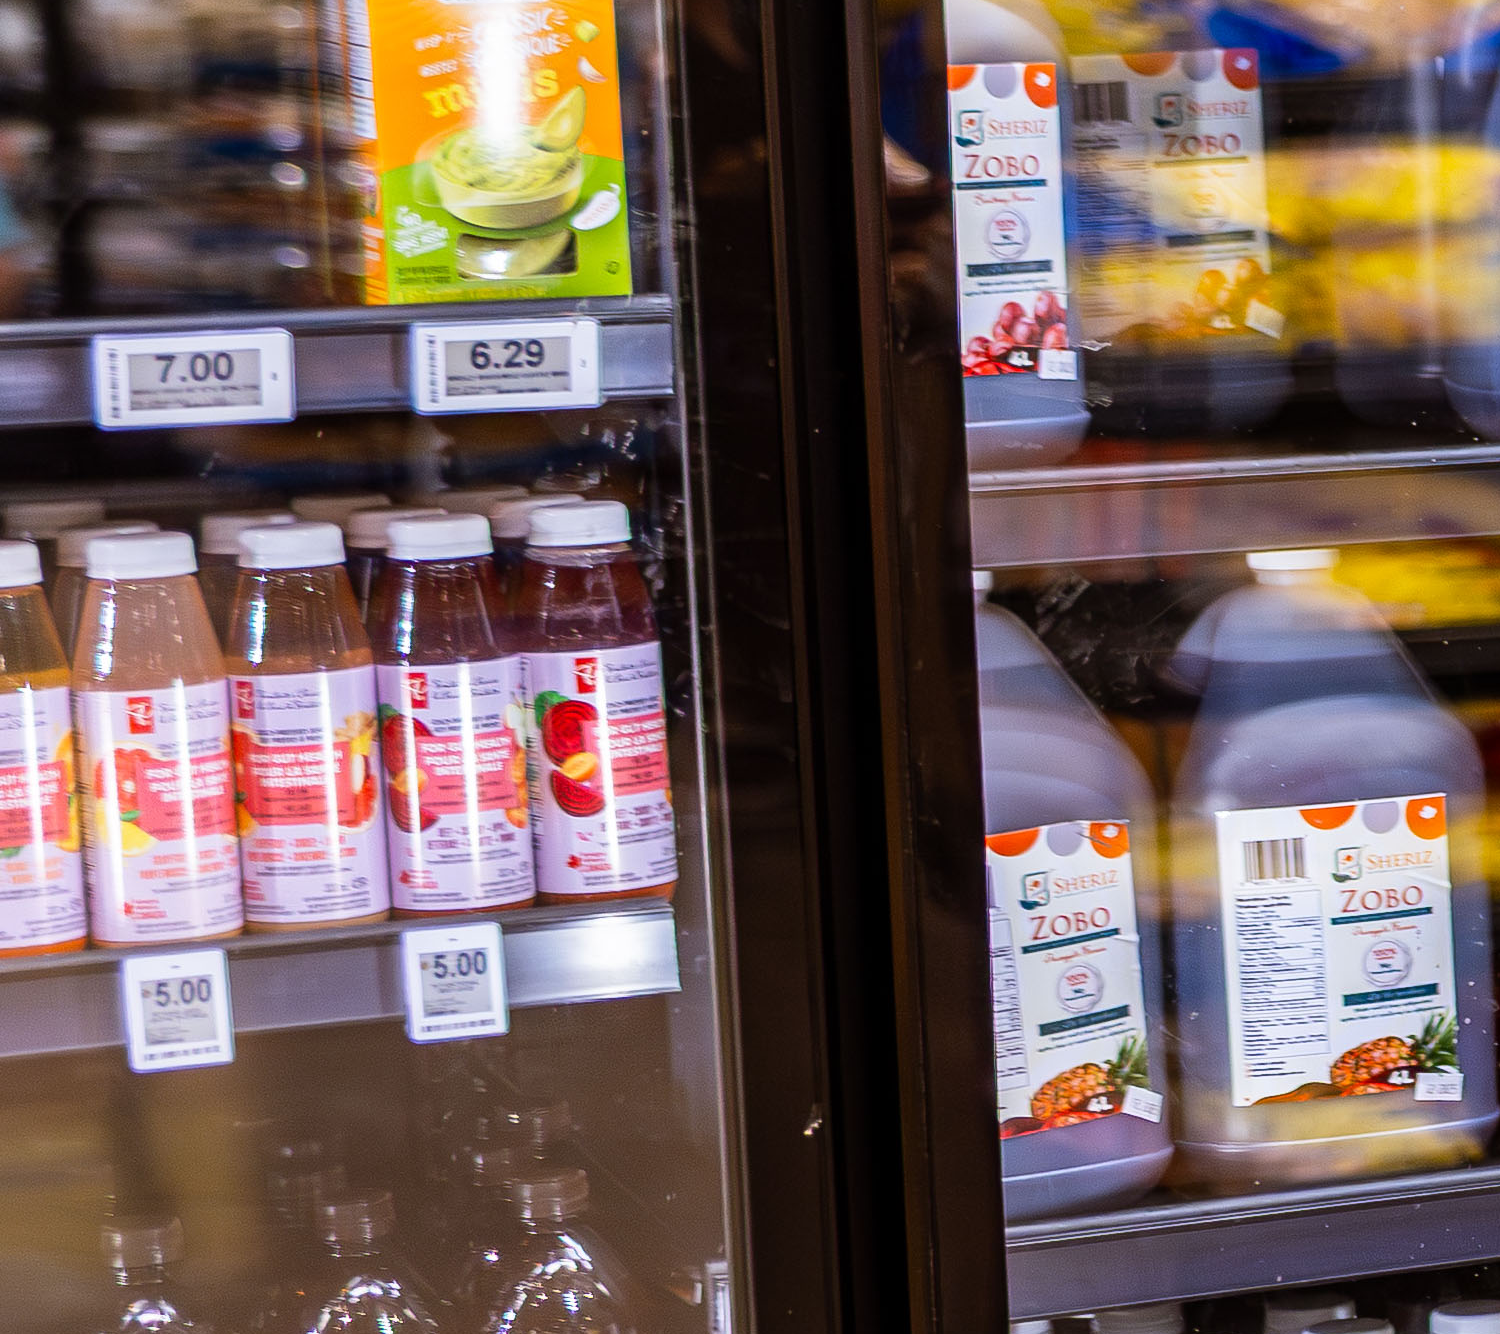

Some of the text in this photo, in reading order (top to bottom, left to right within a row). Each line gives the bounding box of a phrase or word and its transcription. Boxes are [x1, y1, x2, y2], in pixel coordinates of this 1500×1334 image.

[987, 119, 1048, 136] SHERIZ
[1164, 133, 1242, 157] ZOBO
[964, 155, 1040, 179] ZOBO
[156, 352, 234, 383] 7.00
[470, 339, 545, 370] 6.29
[1367, 849, 1434, 870] SHERIZ
[1053, 870, 1118, 895] SHERIZ
[1341, 885, 1423, 913] ZOBO
[1030, 907, 1111, 940] ZOBO
[433, 951, 487, 979] 5.00
[154, 979, 211, 1005] 5.00
